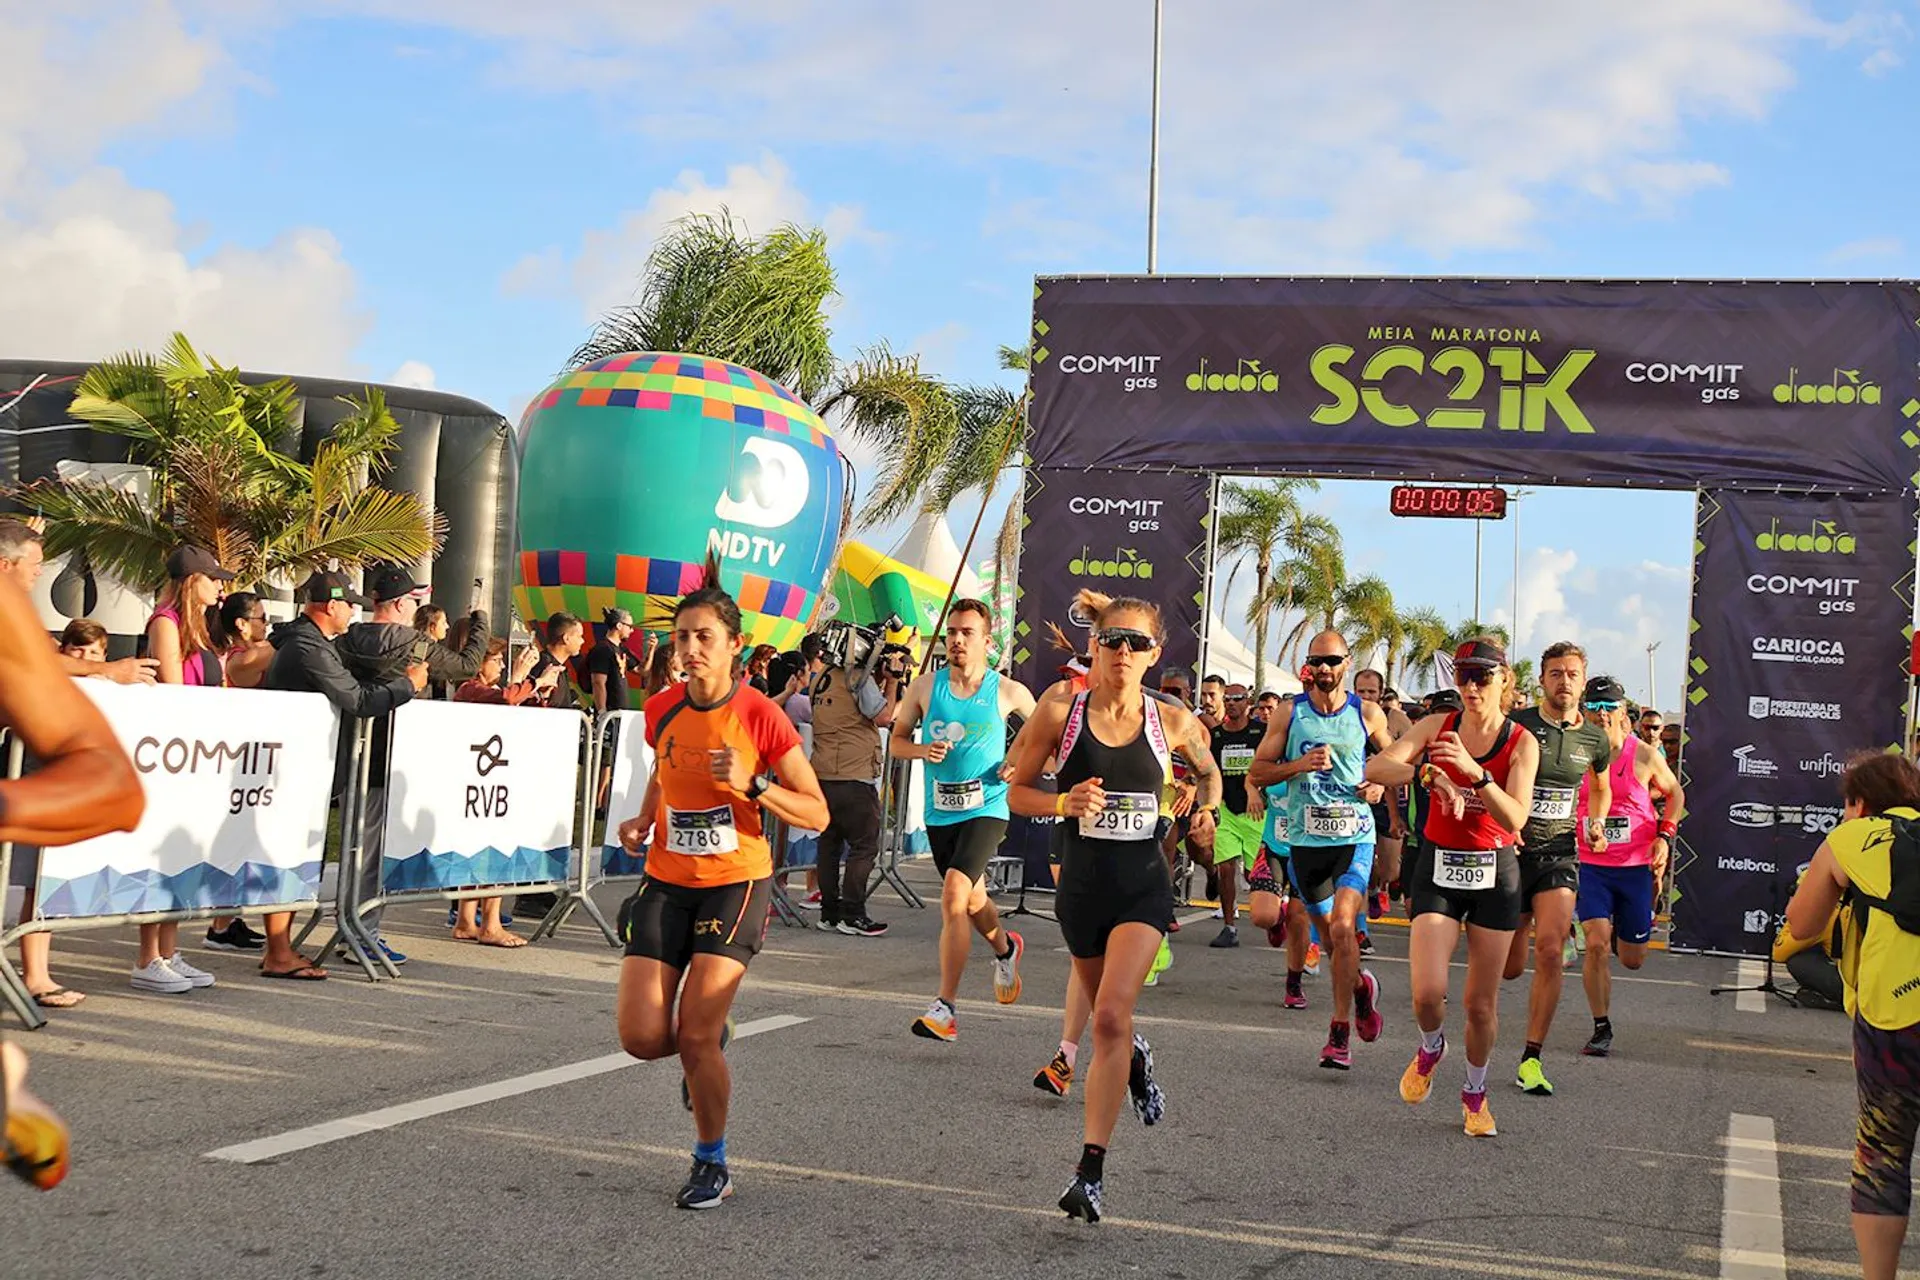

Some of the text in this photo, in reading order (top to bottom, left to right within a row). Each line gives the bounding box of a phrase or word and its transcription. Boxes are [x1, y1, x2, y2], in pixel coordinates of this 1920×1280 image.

[1368, 327, 1541, 342] MEIA MARATONA
[1059, 354, 1161, 374] COMMIT
[1625, 362, 1743, 383] COMMIT
[1186, 357, 1279, 393] diadora
[1309, 343, 1597, 434] SC21K
[1772, 367, 1881, 404] diadora
[1069, 497, 1163, 517] COMMIT
[1395, 488, 1496, 512] 00 00 05
[1755, 517, 1856, 554] diadora
[706, 527, 787, 567] NDTV
[1068, 544, 1153, 579] diadora
[1746, 574, 1860, 597] COMMIT
[1752, 637, 1845, 656] CARIOCA
[1795, 655, 1844, 665] CALÇADOS
[1770, 700, 1841, 712] PREFEITURA DE
[134, 736, 283, 774] COMMIT
[465, 785, 508, 818] RVB
[940, 794, 972, 806] 2807
[1805, 804, 1838, 814] Girando
[1095, 812, 1143, 831] 2916
[1314, 819, 1346, 831] 2809
[1718, 856, 1776, 873] intelbras
[1445, 868, 1484, 883] 2509
